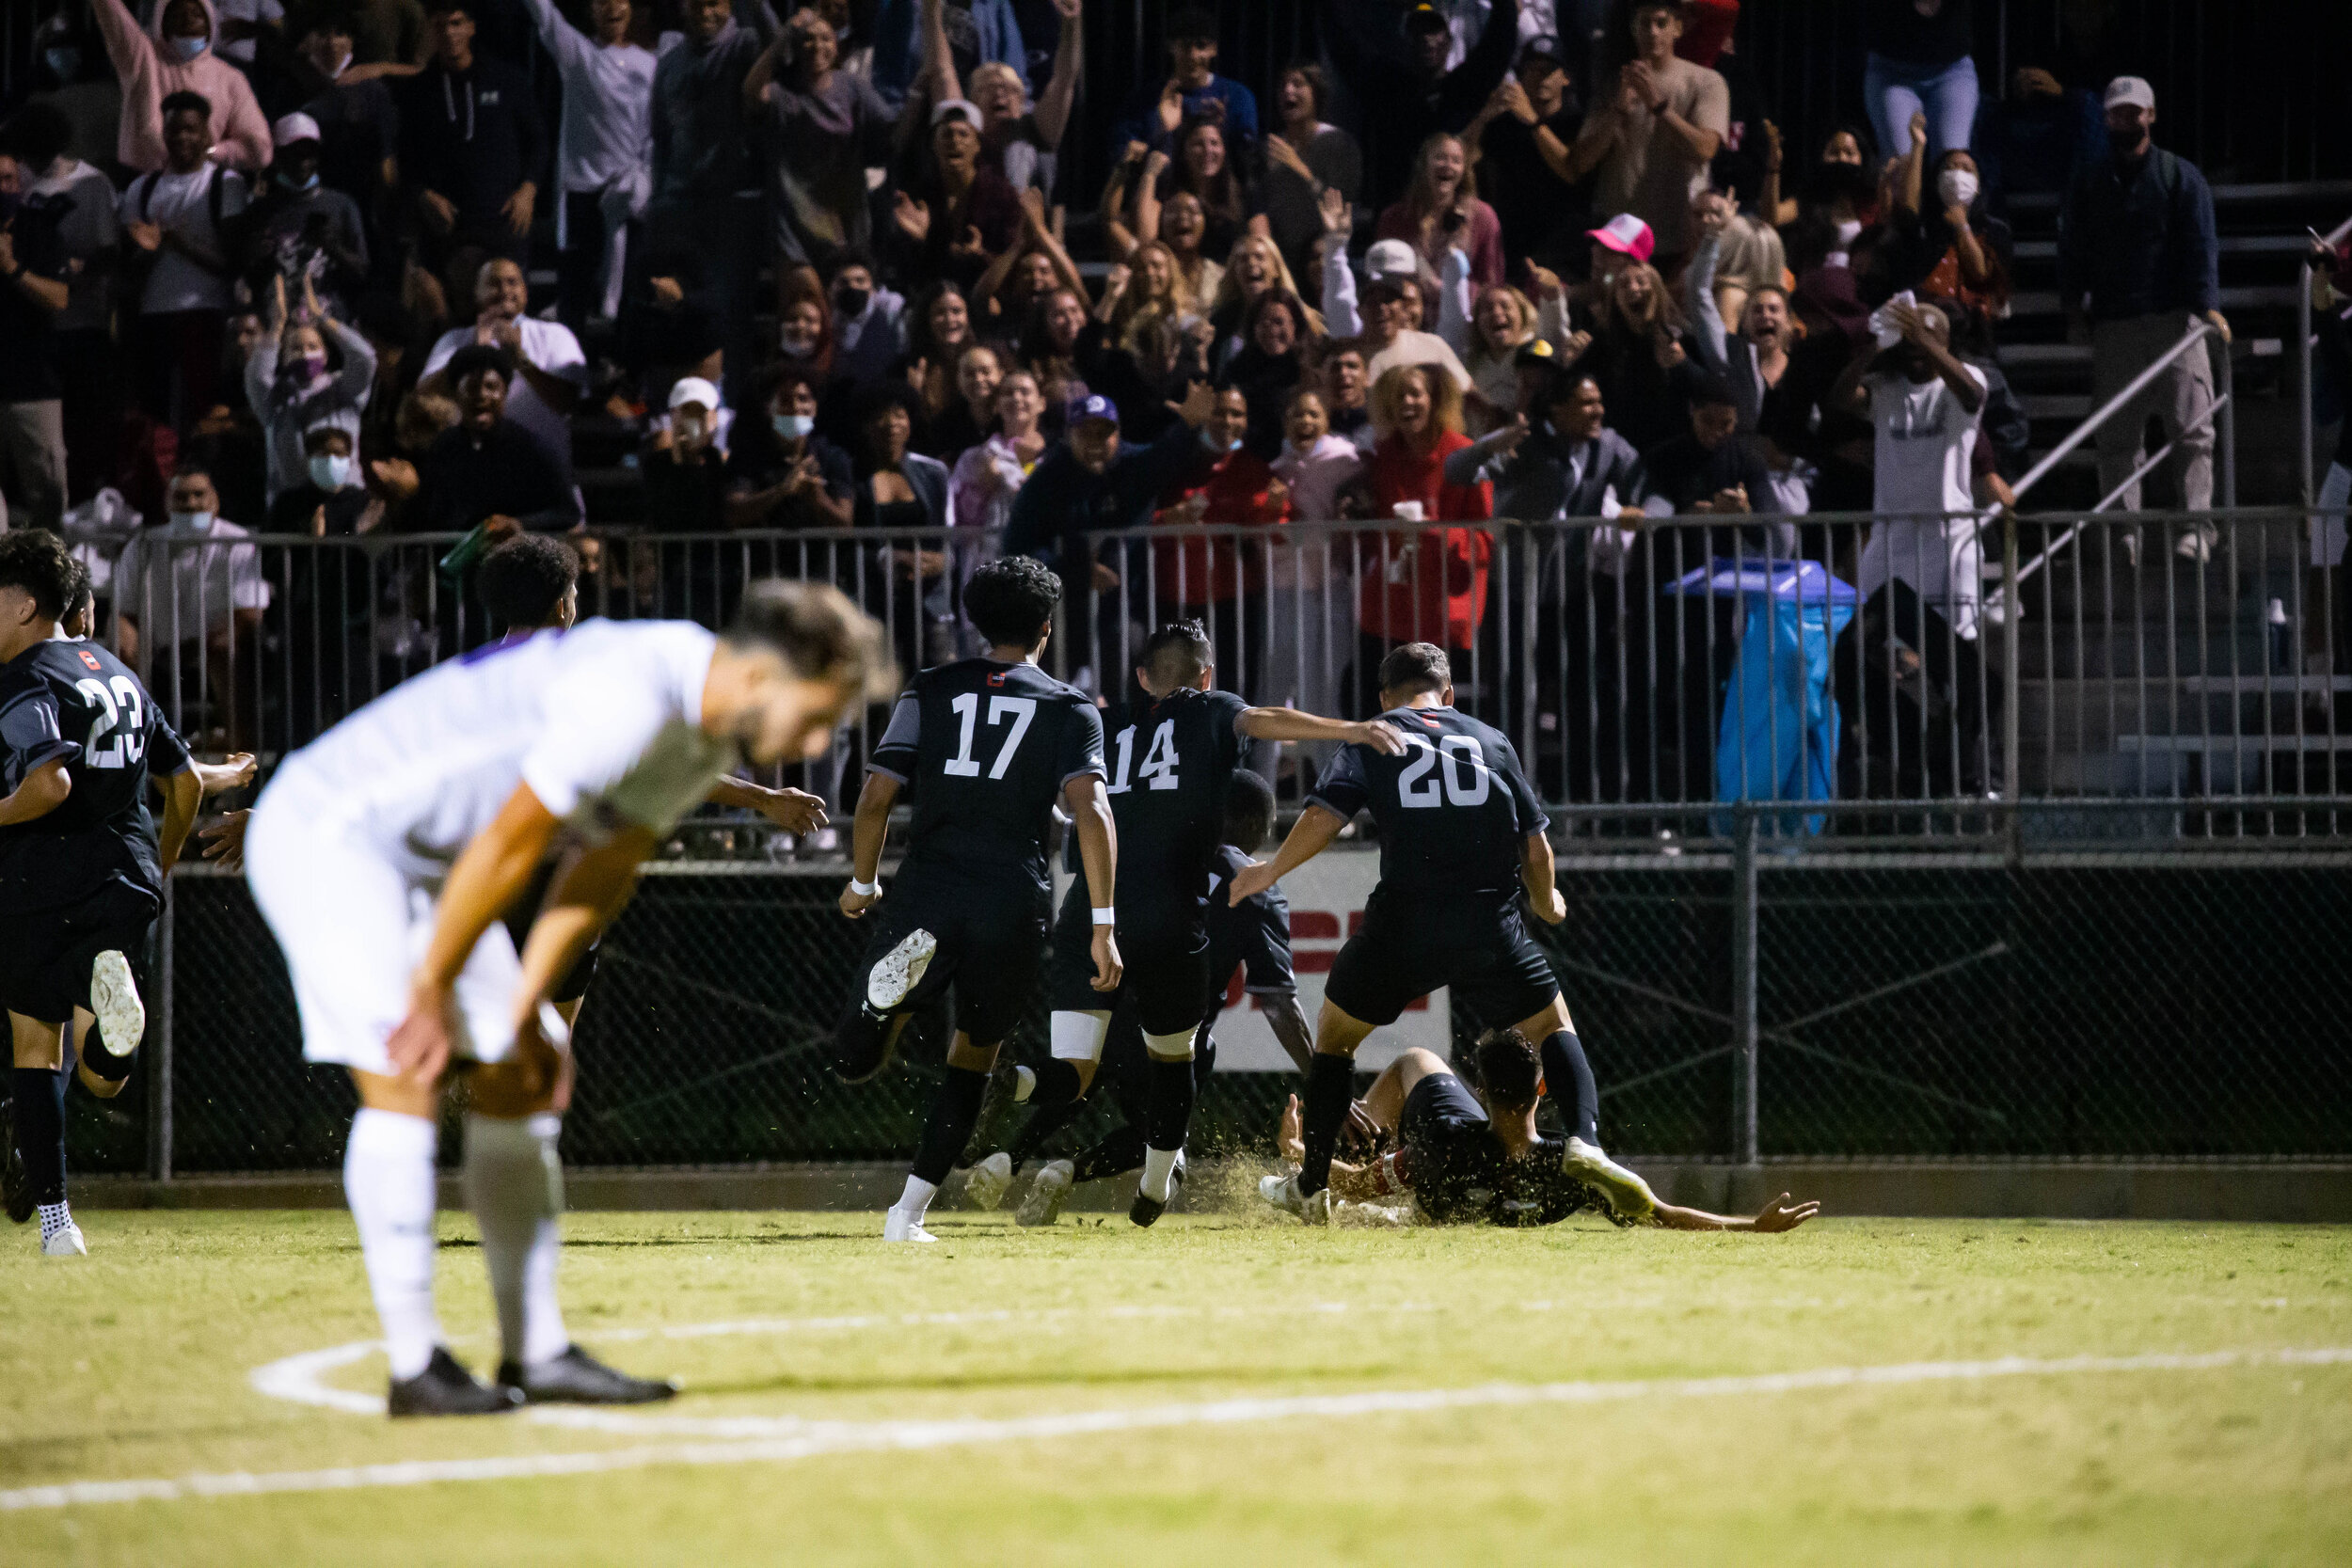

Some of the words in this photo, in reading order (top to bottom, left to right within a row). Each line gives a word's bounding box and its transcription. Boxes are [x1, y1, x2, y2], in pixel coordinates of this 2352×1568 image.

[75, 674, 145, 769] 23
[944, 692, 1037, 780] 17
[1106, 718, 1180, 795] 14
[1398, 732, 1489, 808] 20
